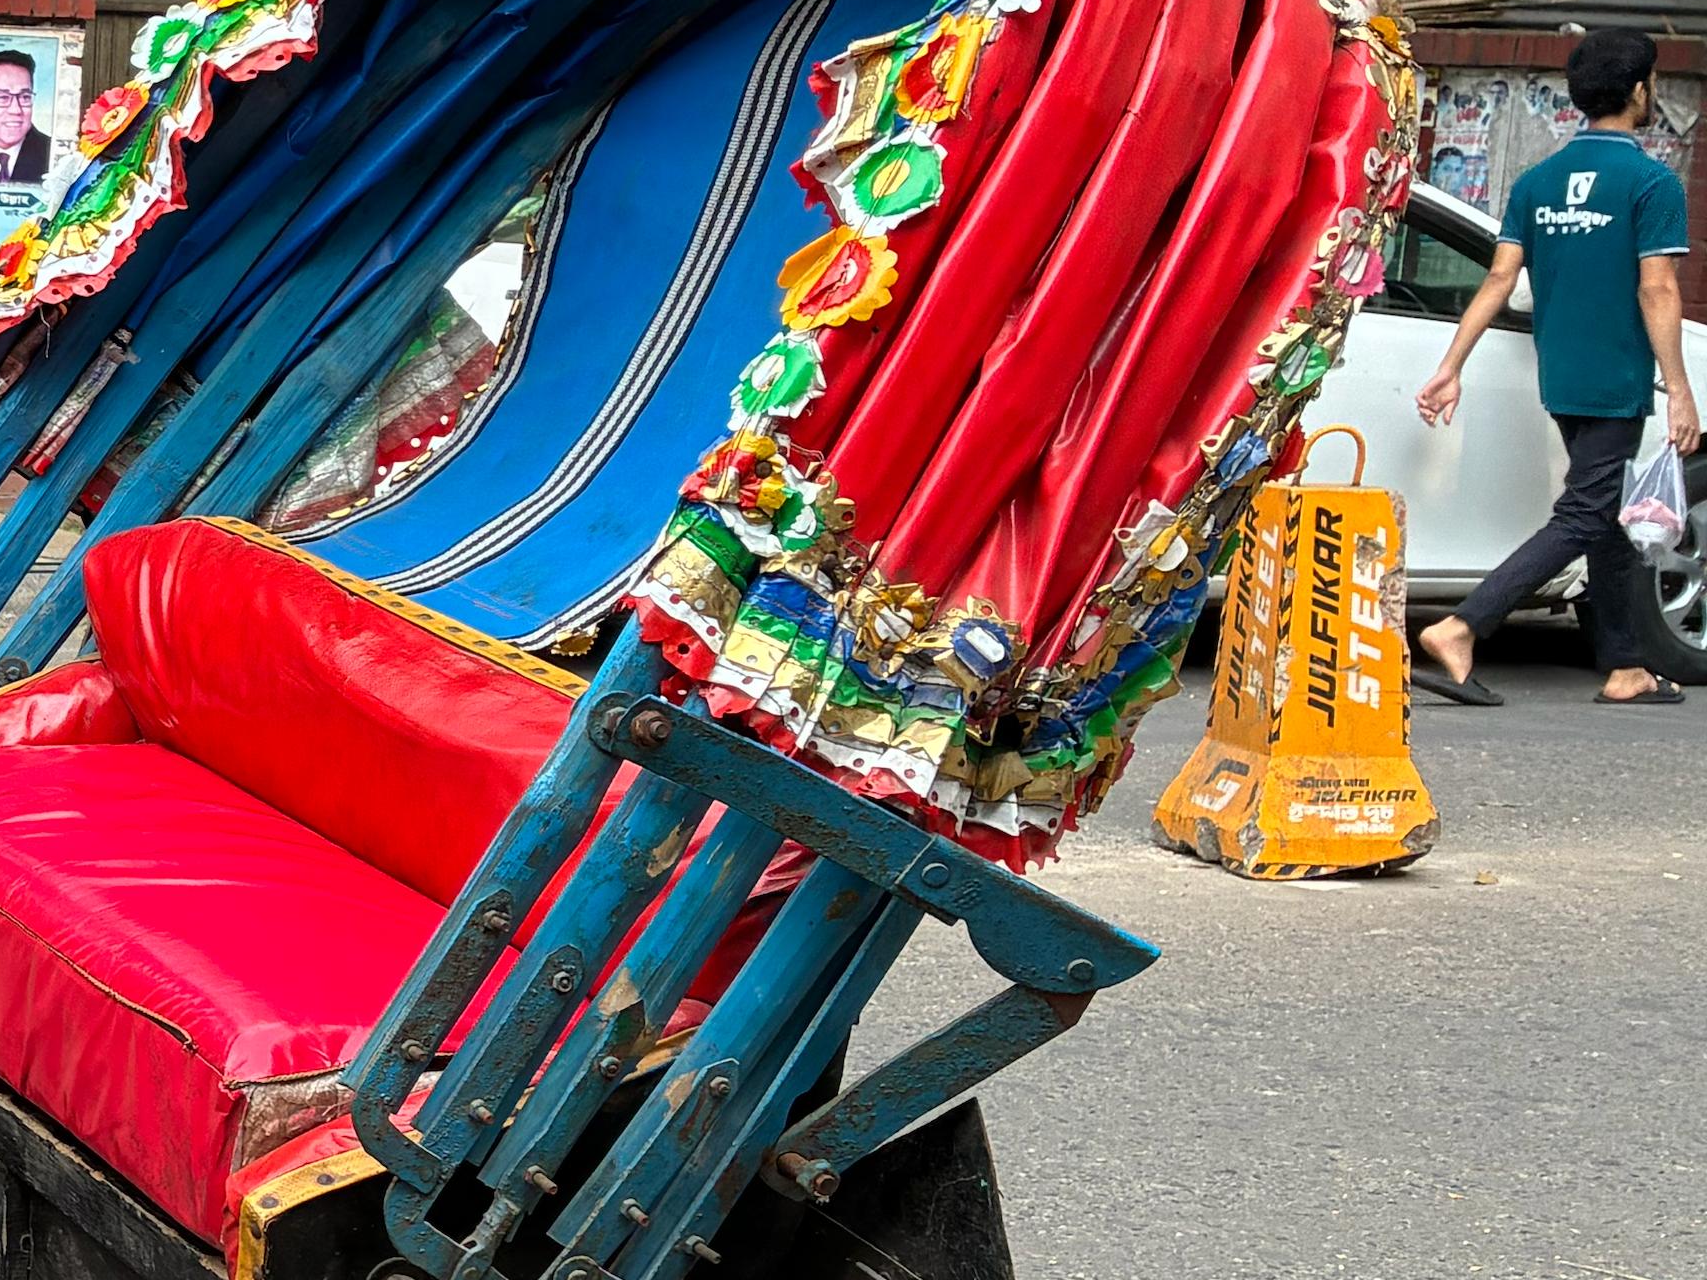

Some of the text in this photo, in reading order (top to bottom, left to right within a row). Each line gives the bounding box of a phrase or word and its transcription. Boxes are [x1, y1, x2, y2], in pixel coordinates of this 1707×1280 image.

[1226, 503, 1260, 720] JULFIKAR
[1241, 524, 1280, 698] STEEL
[1307, 506, 1343, 728] JULFIKAR
[1347, 526, 1388, 711] STEEL
